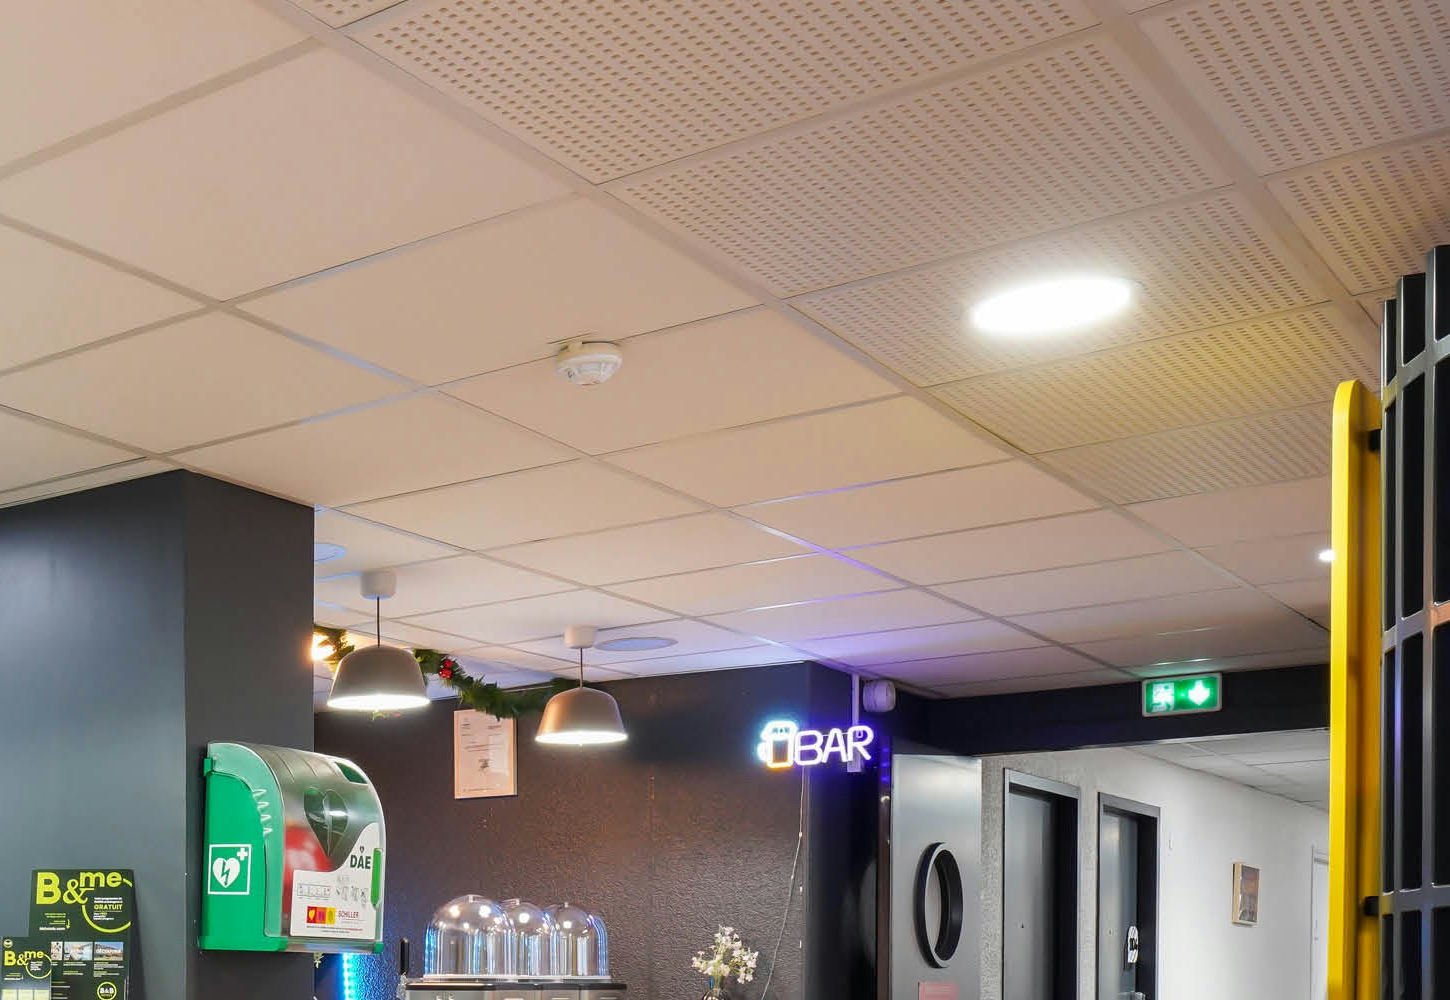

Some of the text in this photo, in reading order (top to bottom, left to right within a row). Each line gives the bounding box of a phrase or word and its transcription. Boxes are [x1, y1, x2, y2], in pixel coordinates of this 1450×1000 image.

[794, 725, 874, 766] BAR
[350, 855, 371, 869] DAE
[36, 872, 122, 904] B&me
[338, 910, 359, 919] SCHILLER
[4, 951, 44, 966] B&me
